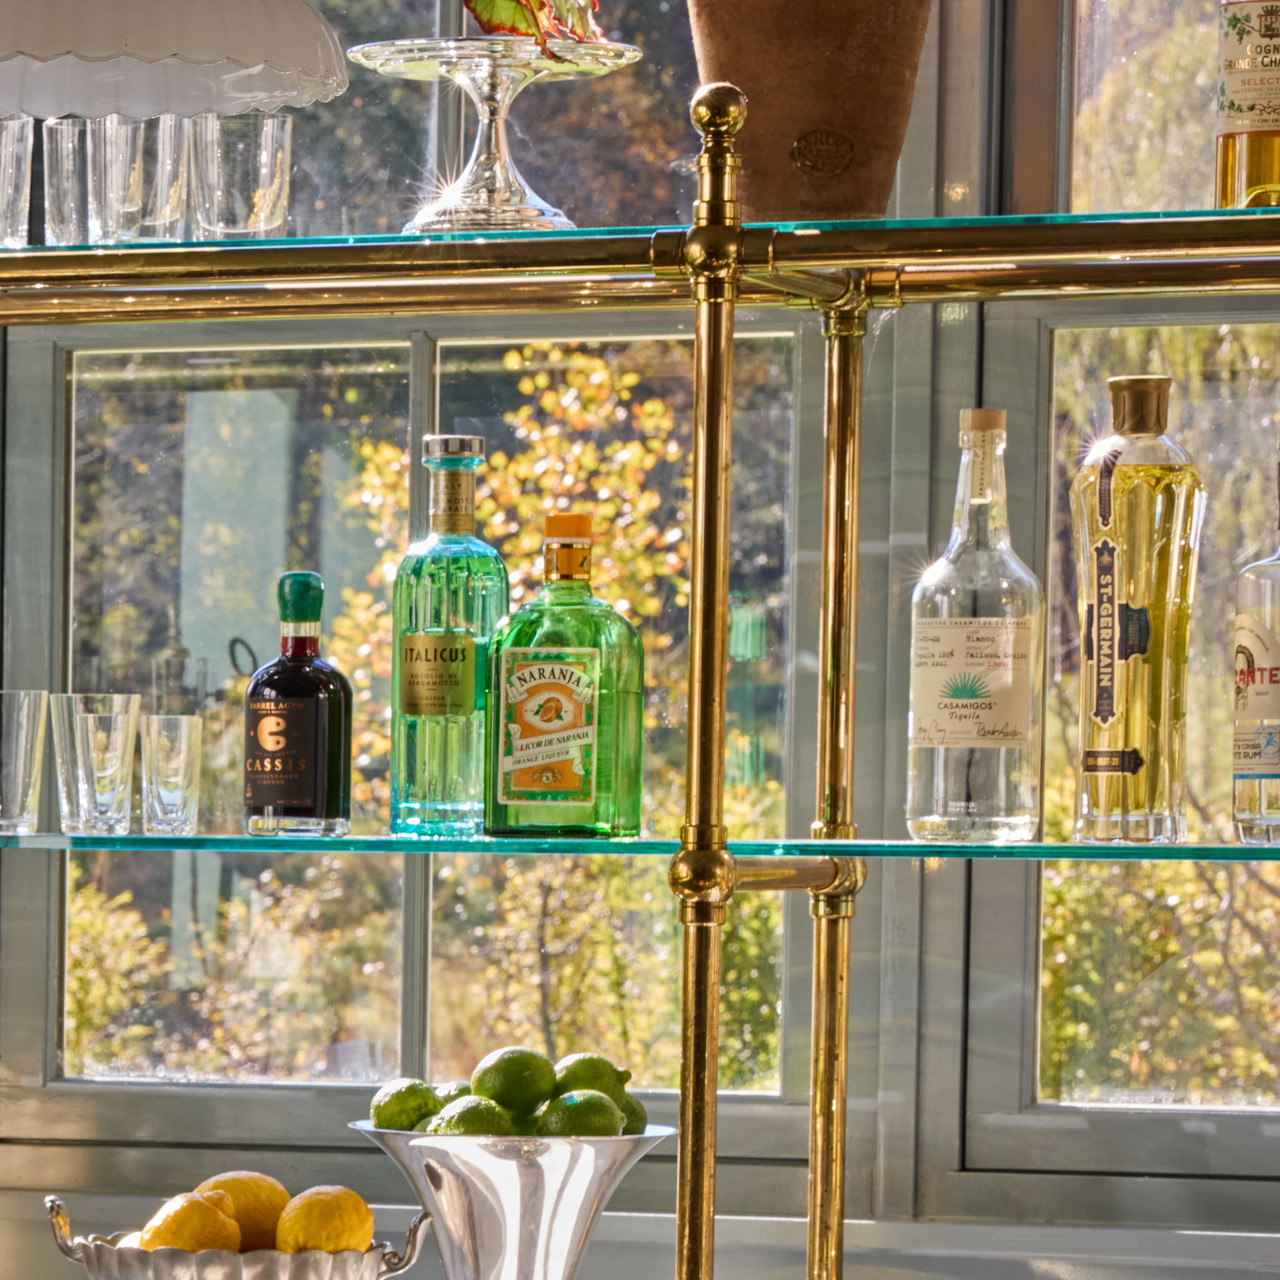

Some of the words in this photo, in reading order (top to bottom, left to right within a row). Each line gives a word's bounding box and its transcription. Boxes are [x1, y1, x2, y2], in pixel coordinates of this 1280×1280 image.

[1223, 58, 1257, 70] GRANDE
[1099, 575, 1112, 687] ST-GERMAIN
[966, 635, 996, 643] Blanco
[405, 647, 467, 662] ITALICUS
[516, 667, 582, 687] NARANJA
[949, 711, 980, 721] Tequila
[520, 739, 543, 751] LICOR
[544, 738, 555, 748] DE
[556, 731, 589, 745] NARANJA
[246, 758, 306, 771] CASSIS
[513, 756, 539, 766] ORANGE
[541, 750, 570, 761] LIQUEUR
